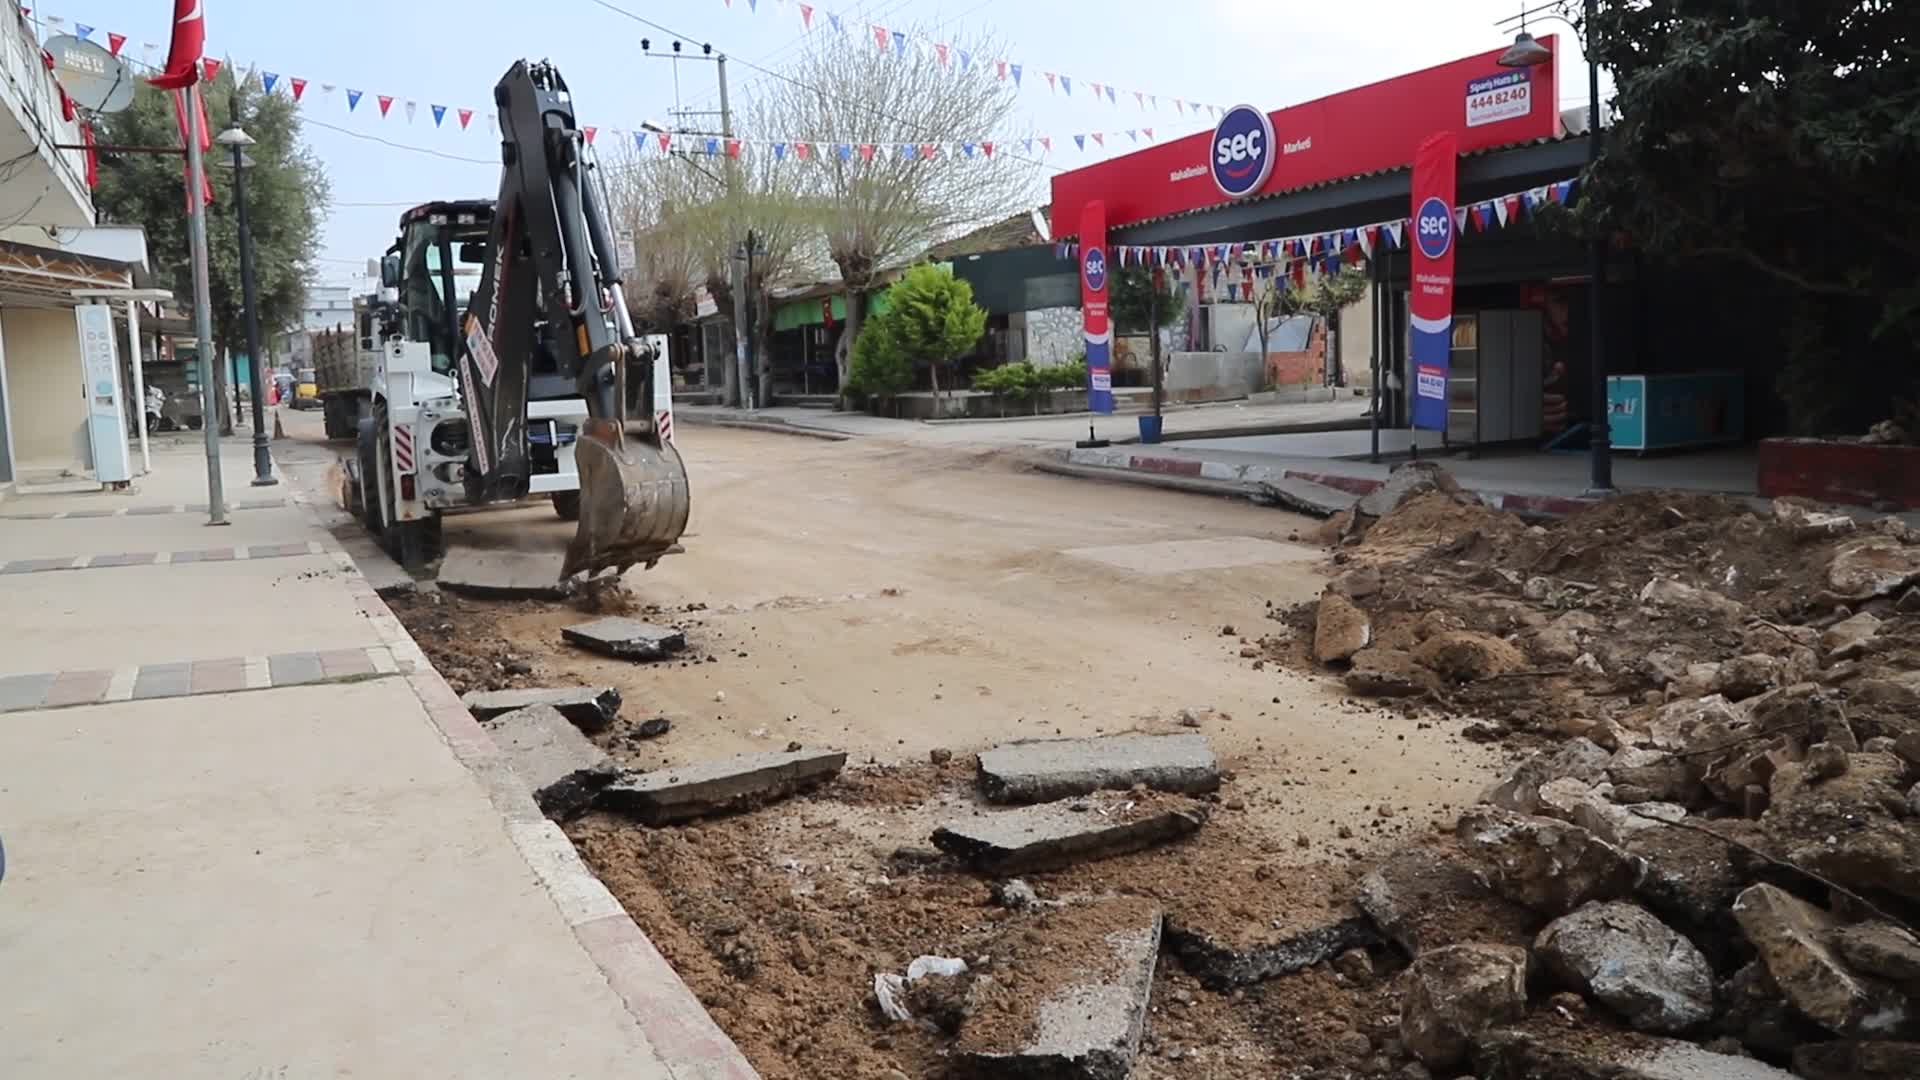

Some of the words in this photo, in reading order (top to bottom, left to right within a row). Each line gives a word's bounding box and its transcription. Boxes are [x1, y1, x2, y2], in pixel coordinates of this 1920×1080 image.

[1471, 95, 1493, 110] 444
[1217, 129, 1261, 165] seç
[1420, 216, 1447, 237] seç
[488, 246, 504, 342] ROMEK
